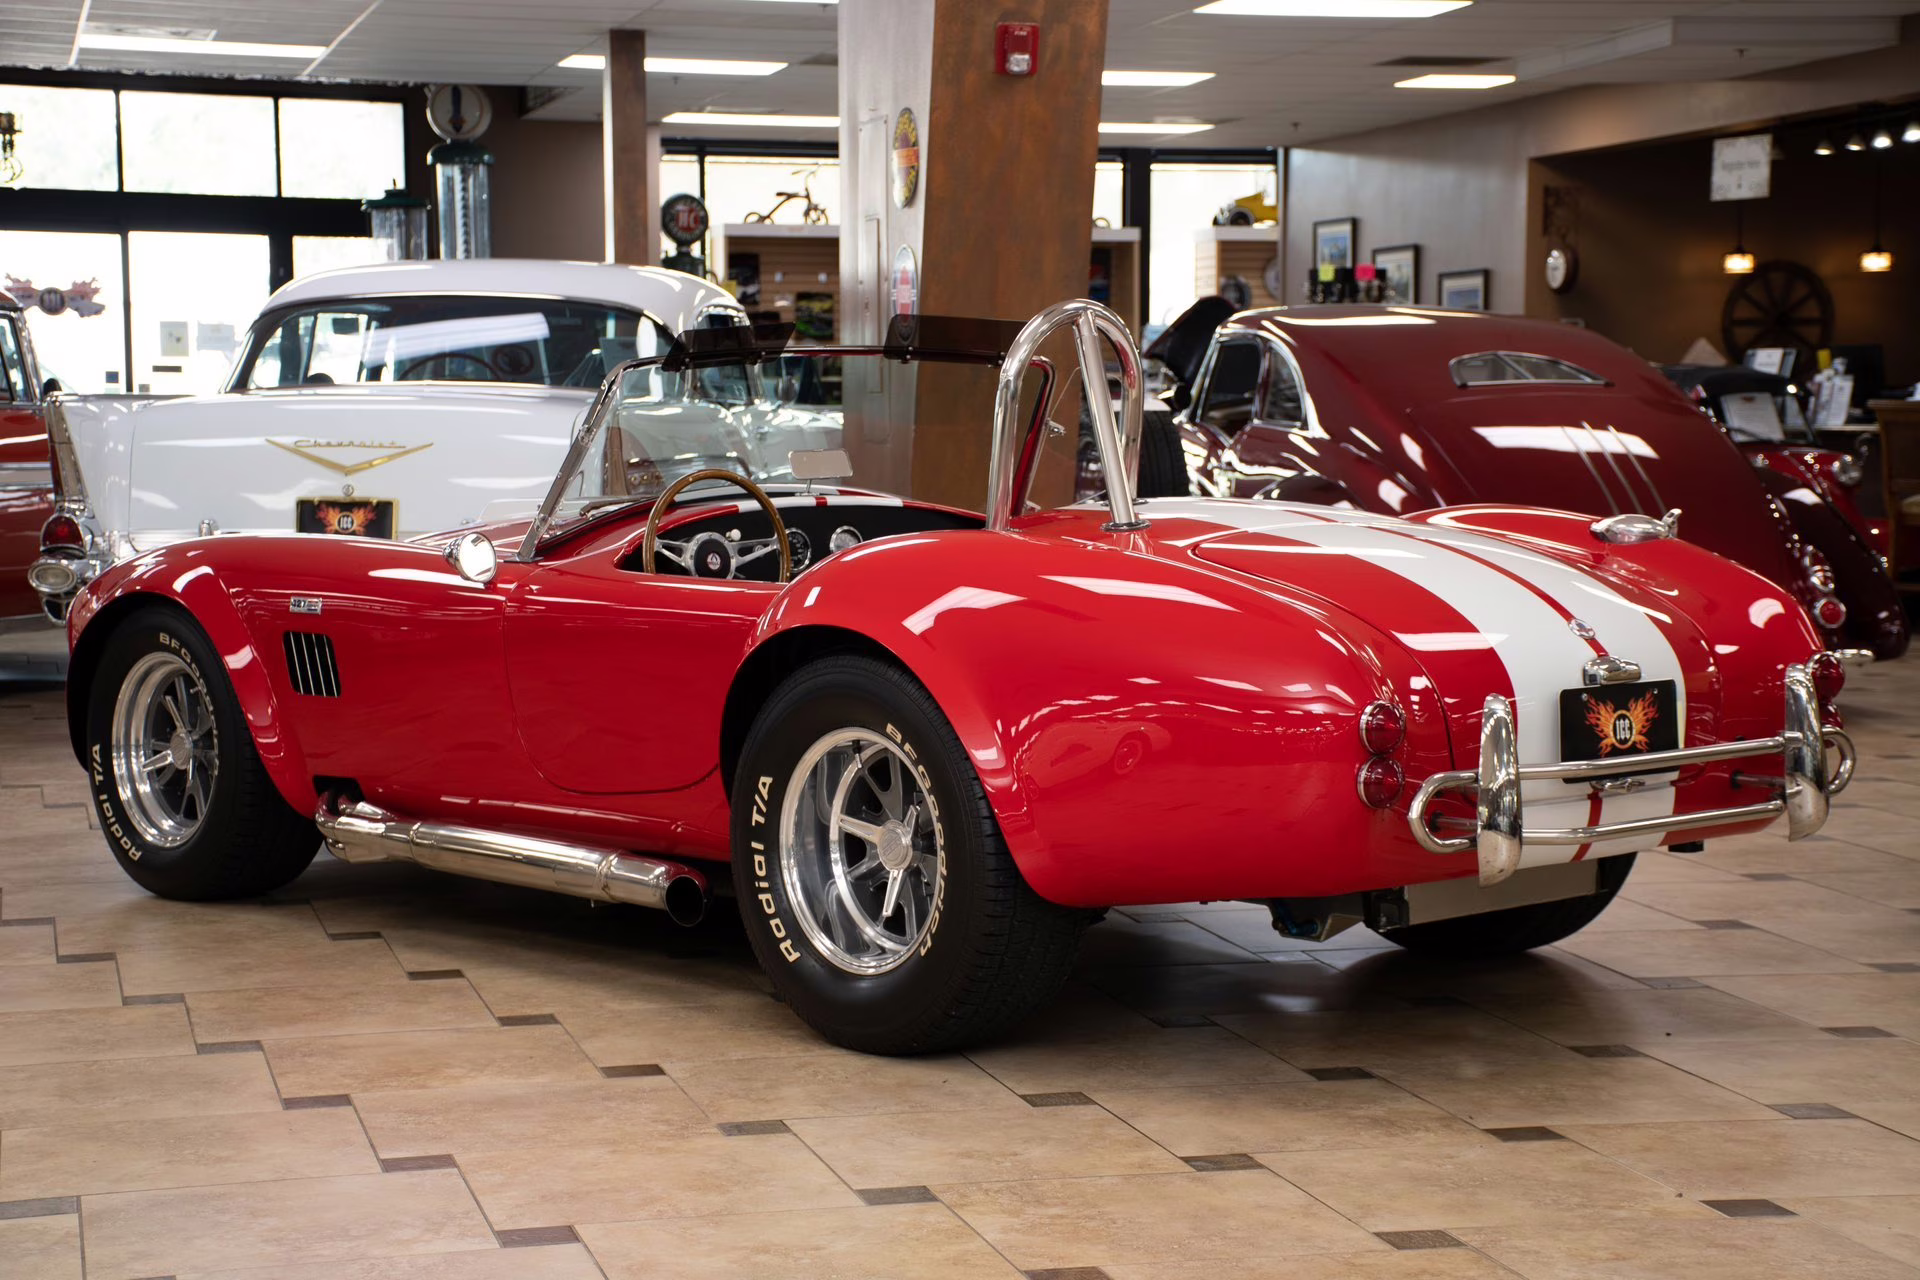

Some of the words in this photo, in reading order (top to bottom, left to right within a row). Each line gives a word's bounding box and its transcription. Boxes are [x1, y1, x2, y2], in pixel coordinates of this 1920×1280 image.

[92, 743, 104, 786] T/A
[98, 793, 142, 861] Radial
[752, 776, 773, 826] T/A
[886, 723, 948, 957] BFGoodrich
[751, 841, 801, 963] Radial
